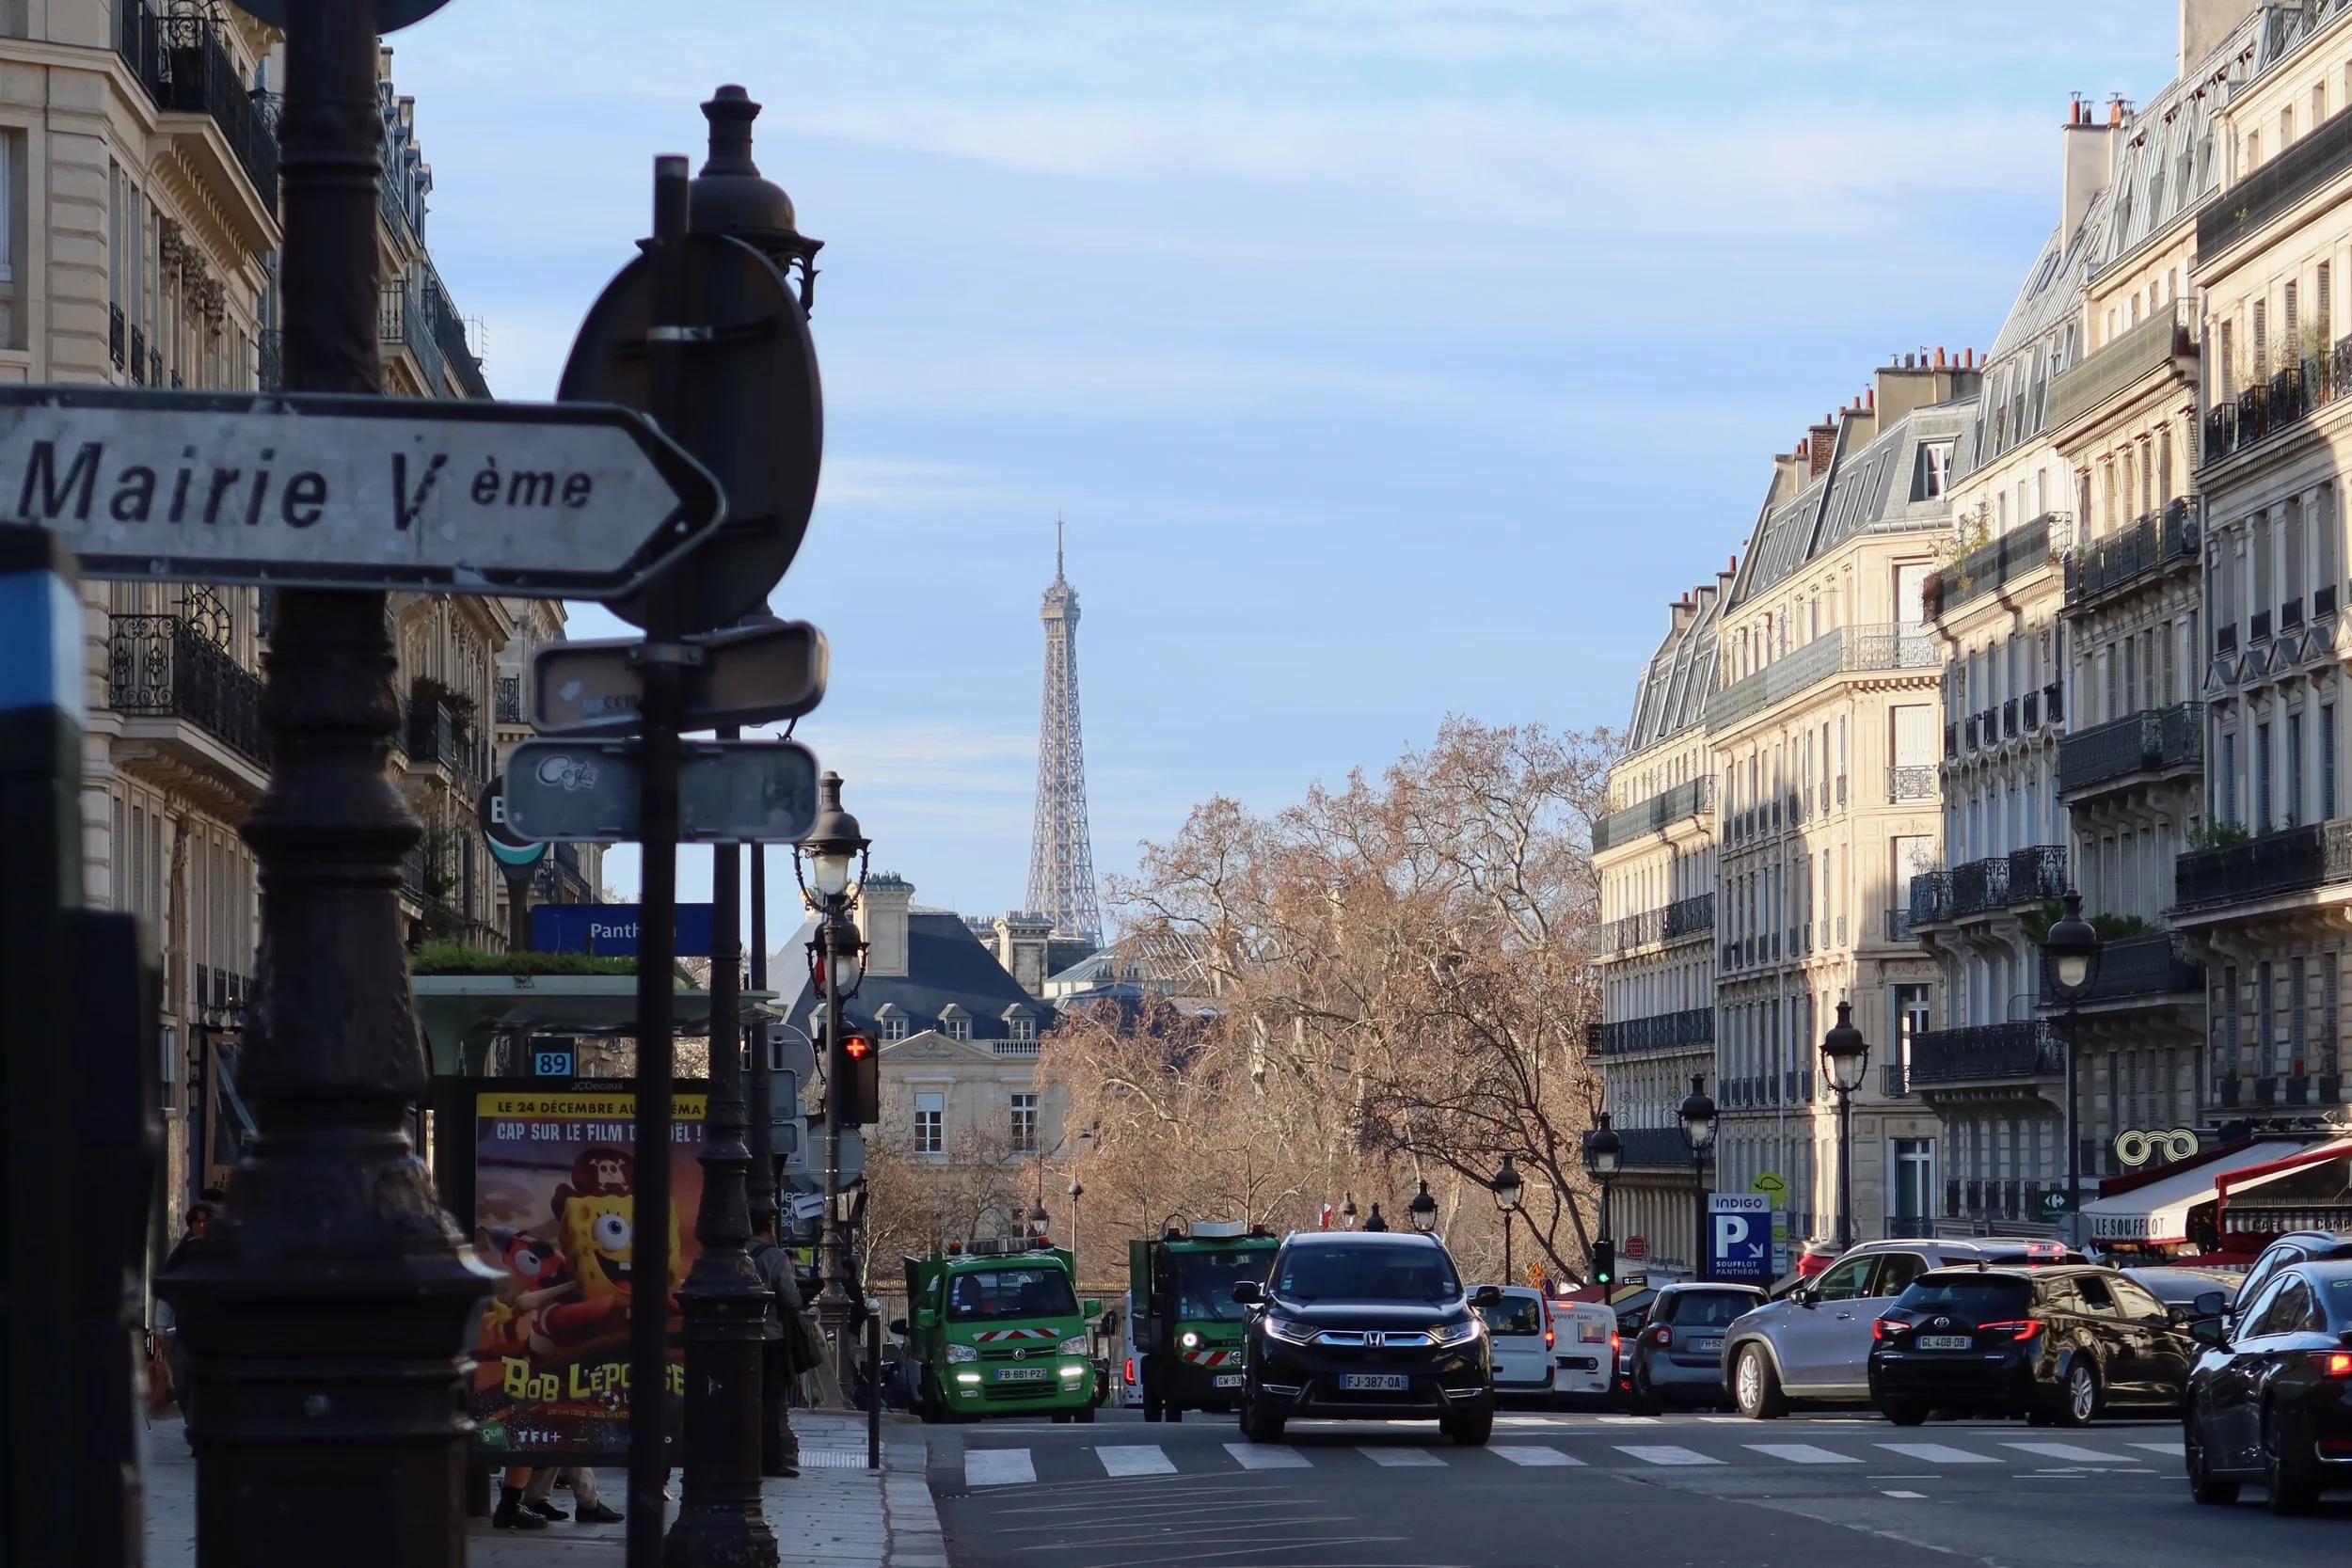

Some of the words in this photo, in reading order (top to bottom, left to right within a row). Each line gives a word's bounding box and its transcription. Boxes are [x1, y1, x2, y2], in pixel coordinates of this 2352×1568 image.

[17, 439, 327, 530] Mairie
[591, 922, 676, 939] Panth
[539, 1054, 566, 1074] 89
[571, 1082, 624, 1091] JCDecaux
[498, 1101, 513, 1113] LE
[517, 1101, 535, 1114] 24
[540, 1100, 613, 1115] DÉCEMBRE
[671, 1101, 701, 1115] ÉMA
[497, 1122, 525, 1141] CAP
[532, 1123, 560, 1142] SUR
[566, 1123, 580, 1142] LE
[587, 1123, 623, 1142] FILM
[1715, 1198, 1763, 1209] INDIGO
[2095, 1218, 2107, 1236] LE
[2110, 1217, 2166, 1236] SOUFFLOT
[1715, 1214, 1749, 1259] P
[1716, 1267, 1760, 1275] PANTHÉON
[1700, 1339, 1724, 1348] FH-52
[569, 1363, 685, 1399] L'ÉPOE
[1218, 1376, 1241, 1386] GW-93
[483, 1427, 503, 1442] gulli
[517, 1431, 562, 1443] TF1+
